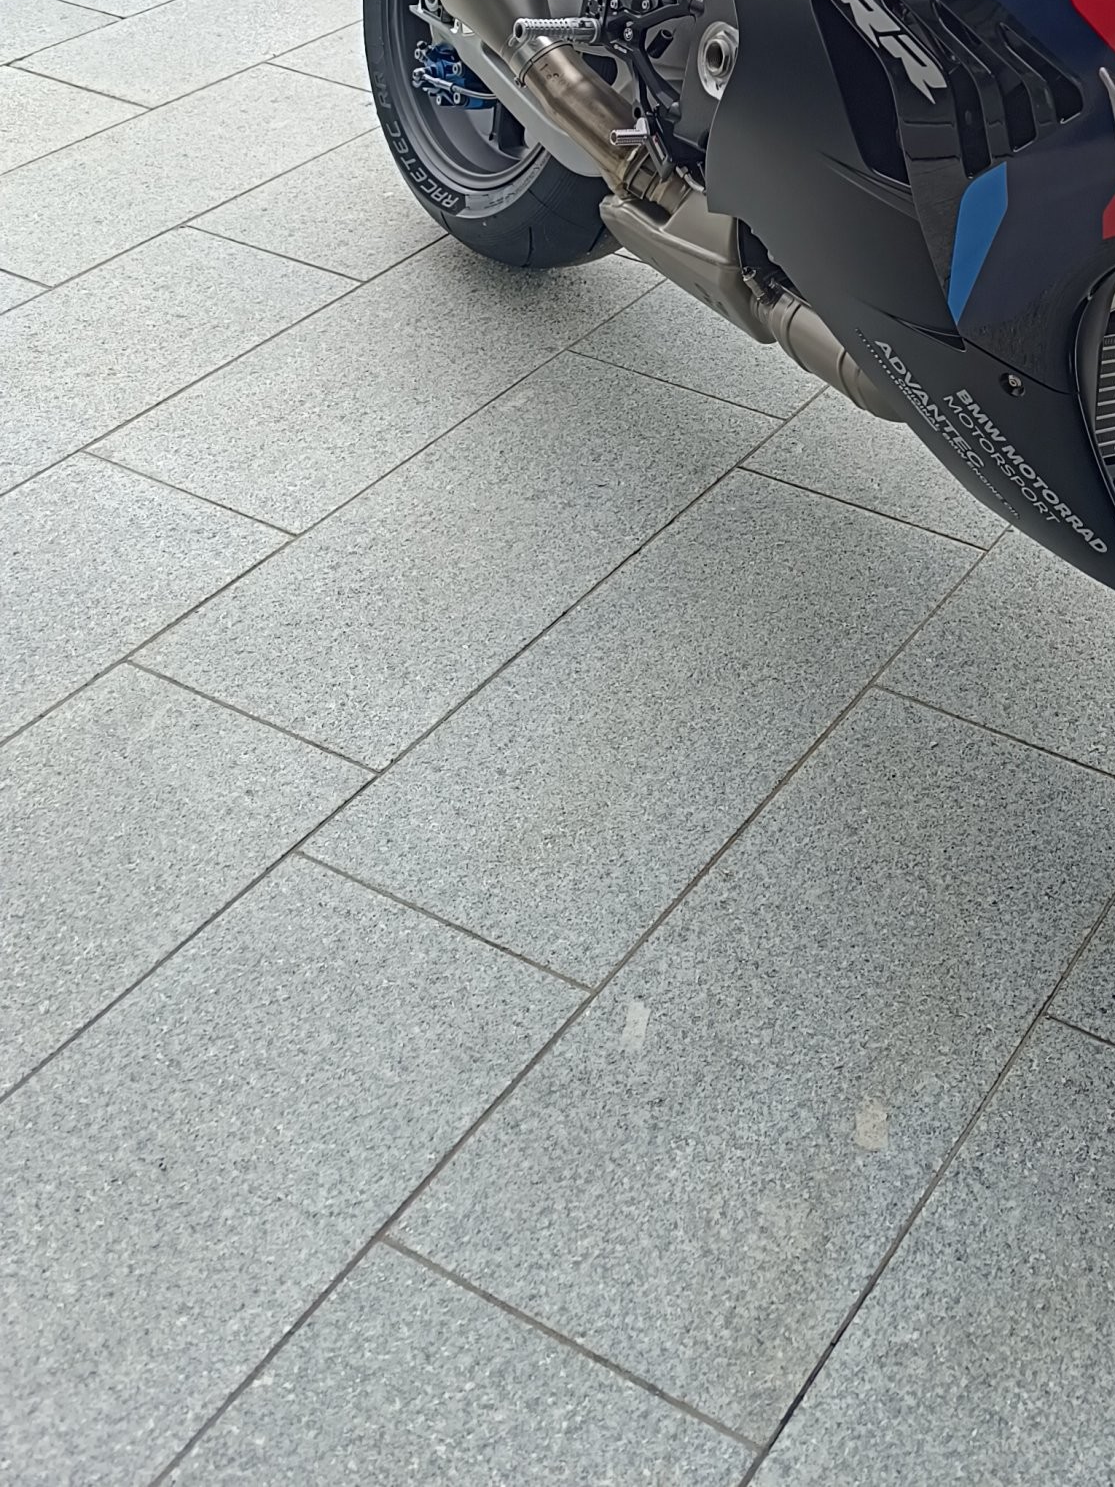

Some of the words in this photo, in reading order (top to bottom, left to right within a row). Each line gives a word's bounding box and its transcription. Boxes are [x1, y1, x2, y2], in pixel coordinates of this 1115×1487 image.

[386, 120, 459, 208] RACETEC
[874, 340, 984, 468] ADVANTEC
[943, 395, 1062, 524] MOTORSPORT
[956, 388, 1008, 443] BMW
[1001, 444, 1108, 554] MOTORRAD
